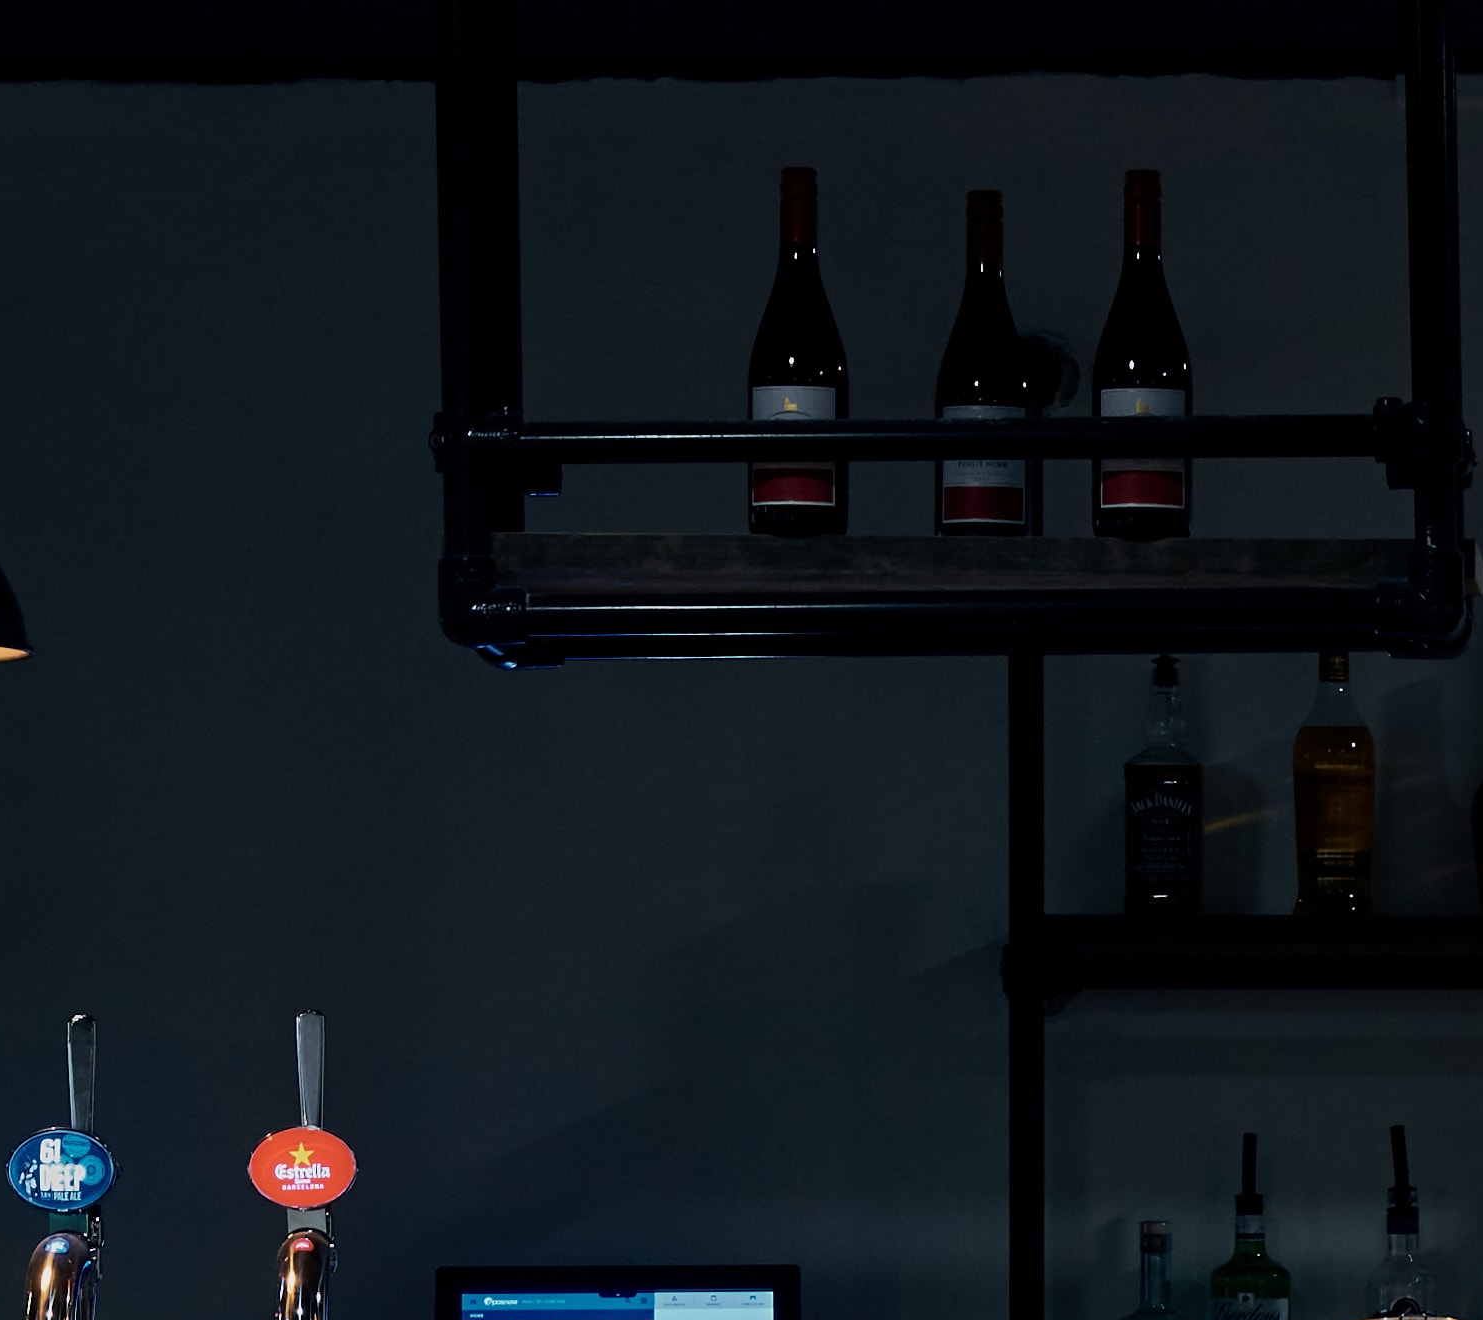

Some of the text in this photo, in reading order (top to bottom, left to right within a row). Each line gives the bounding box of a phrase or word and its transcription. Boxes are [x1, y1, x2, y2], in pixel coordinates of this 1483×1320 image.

[1130, 797, 1154, 816] JACK
[40, 1138, 62, 1163] 61
[39, 1163, 86, 1192] DEEP
[274, 1163, 330, 1180] Estrella
[69, 1192, 82, 1201] ALE
